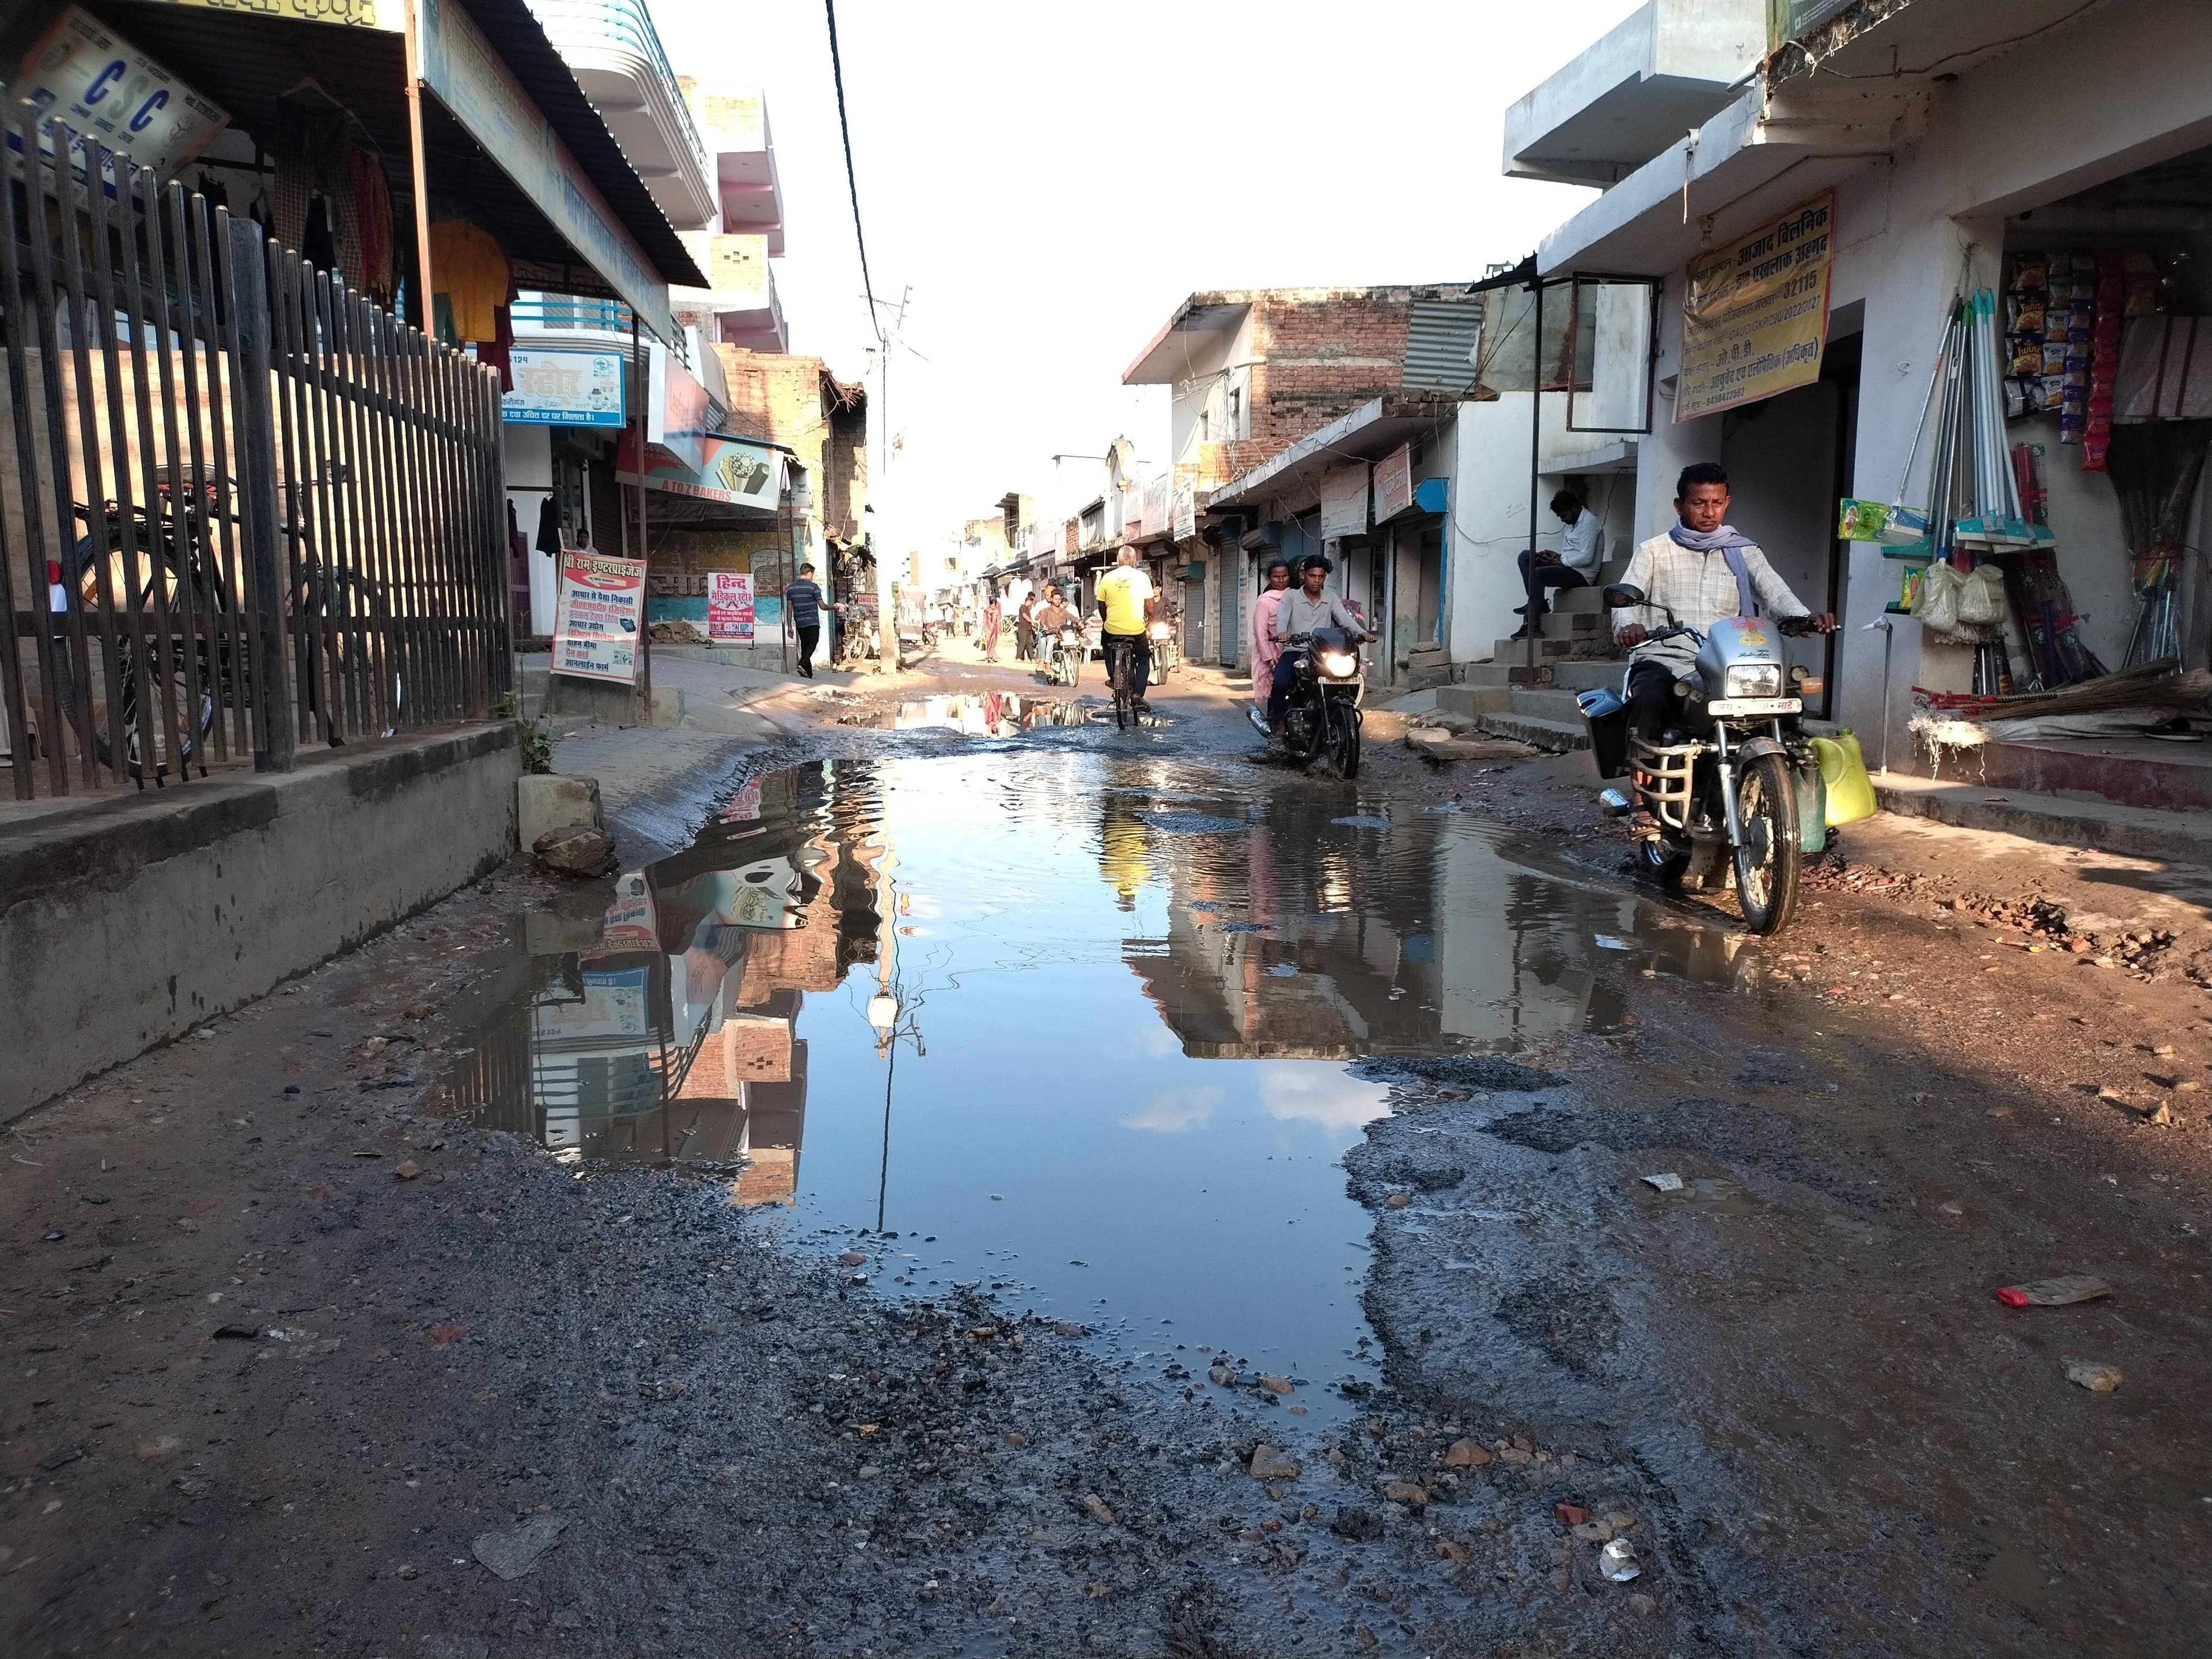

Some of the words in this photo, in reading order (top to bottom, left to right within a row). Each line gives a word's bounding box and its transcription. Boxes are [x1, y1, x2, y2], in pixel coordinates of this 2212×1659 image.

[84, 60, 169, 132] CSC
[1783, 269, 1817, 300] 32115
[518, 359, 582, 399] स्टोर
[522, 410, 540, 419] उचित
[562, 411, 584, 421] मिलता
[662, 479, 669, 490] A
[671, 482, 683, 493] TO
[685, 484, 692, 494] Z
[693, 486, 732, 502] BAKERS
[576, 558, 590, 570] राम
[716, 574, 747, 590] हिन्द
[571, 589, 589, 599] आधार
[592, 590, 597, 599] से
[598, 591, 609, 601] पैसा
[611, 594, 634, 605] निकासी
[711, 589, 737, 601] मेडिकल
[738, 590, 752, 601] स्टोर
[569, 619, 587, 628] आधार
[567, 639, 582, 647] वाहन
